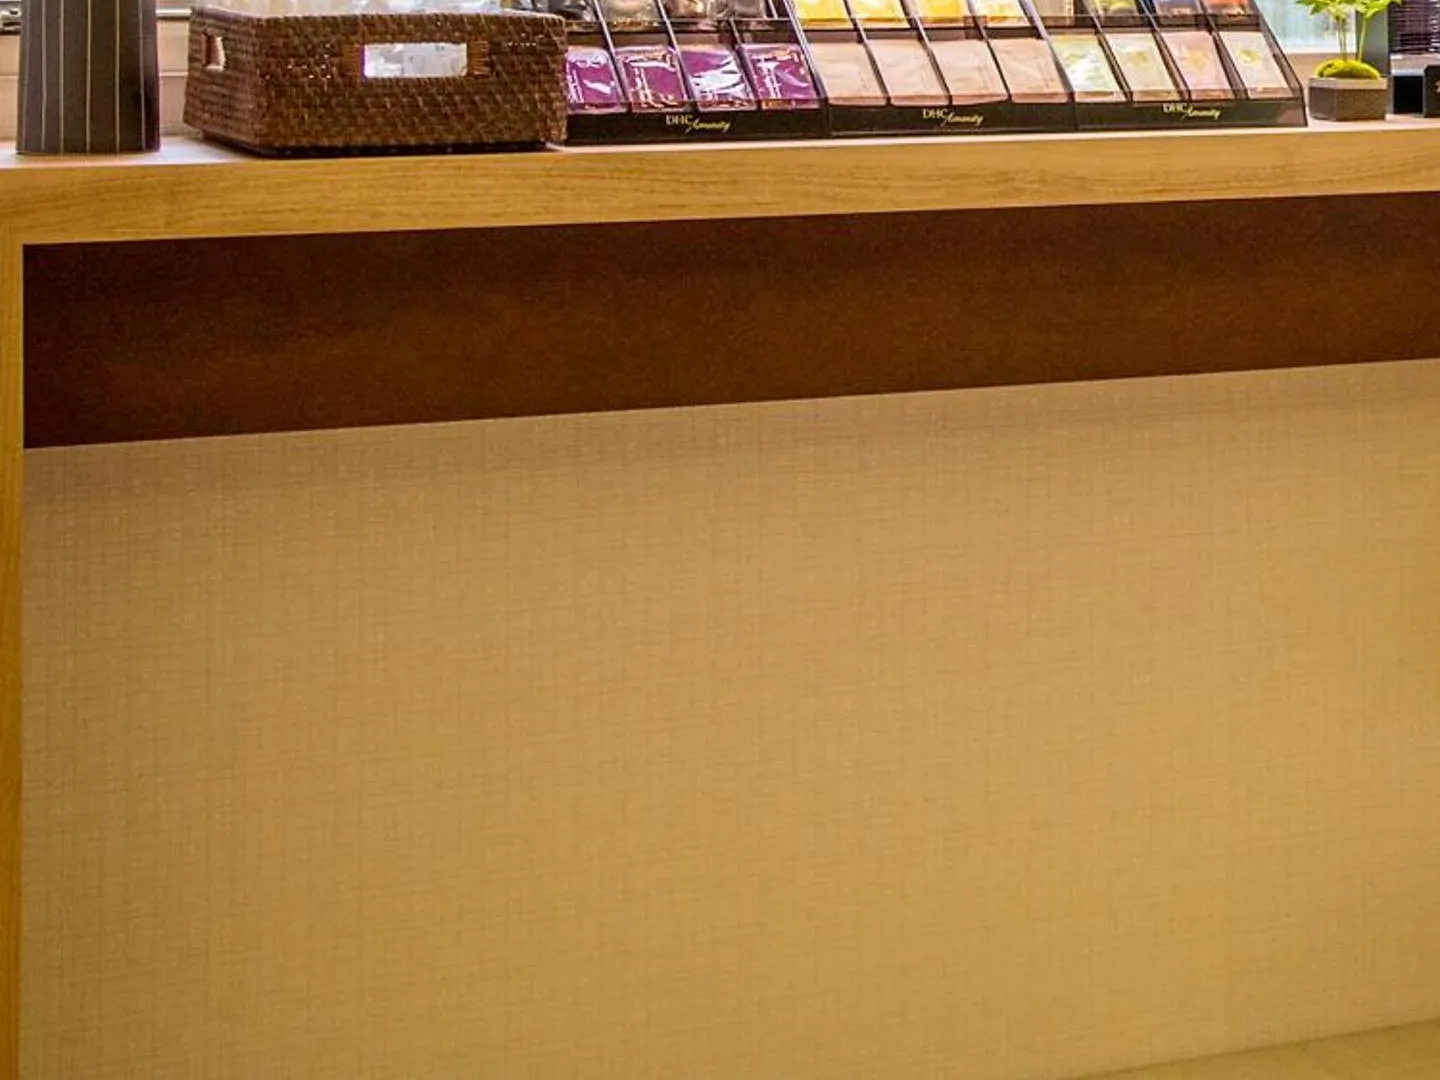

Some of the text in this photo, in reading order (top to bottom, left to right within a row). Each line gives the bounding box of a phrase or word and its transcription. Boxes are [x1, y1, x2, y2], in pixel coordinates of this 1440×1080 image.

[1162, 102, 1187, 113] DHC
[922, 108, 948, 119] DHC
[665, 114, 693, 125] DHC
